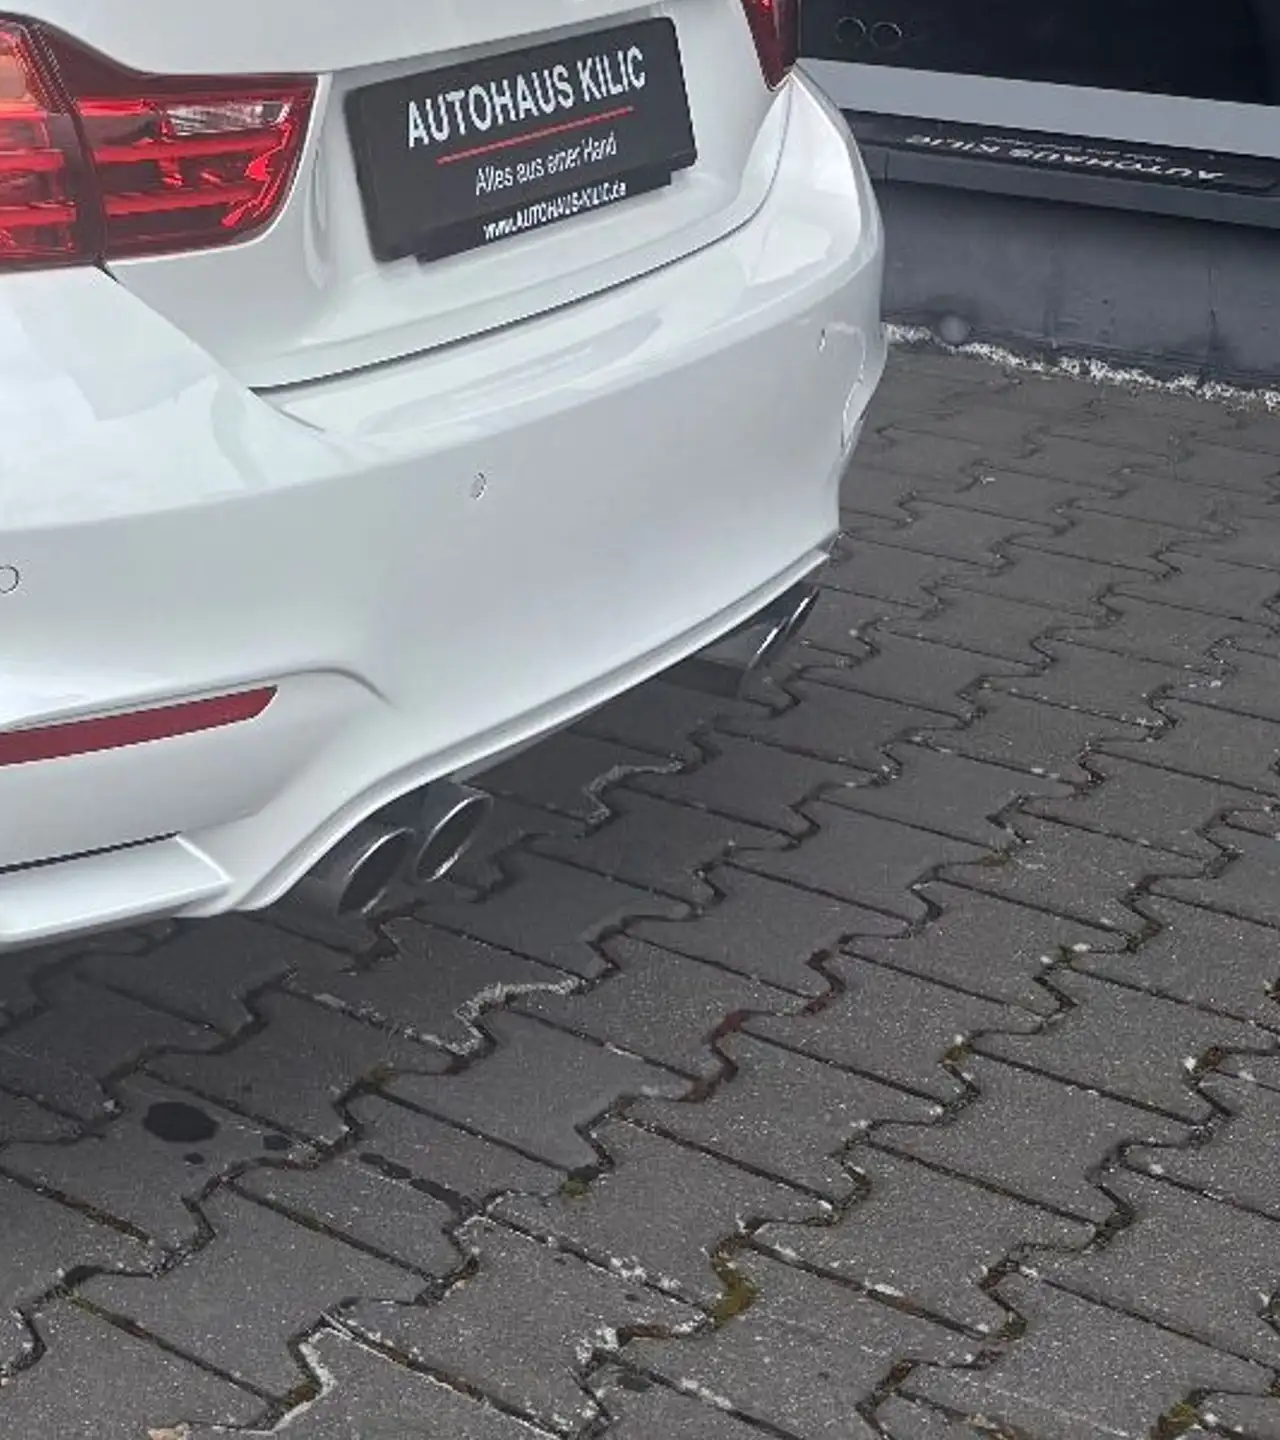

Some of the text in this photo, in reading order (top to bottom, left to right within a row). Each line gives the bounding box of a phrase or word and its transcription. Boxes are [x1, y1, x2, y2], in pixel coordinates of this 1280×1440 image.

[407, 46, 646, 150] AUTOHAUS KILIC
[475, 130, 617, 196] Alles aus einer Hand
[1008, 149, 1224, 179] AUTOHAUS
[483, 180, 627, 241] www.AUTOHAUS-KILIC.de
